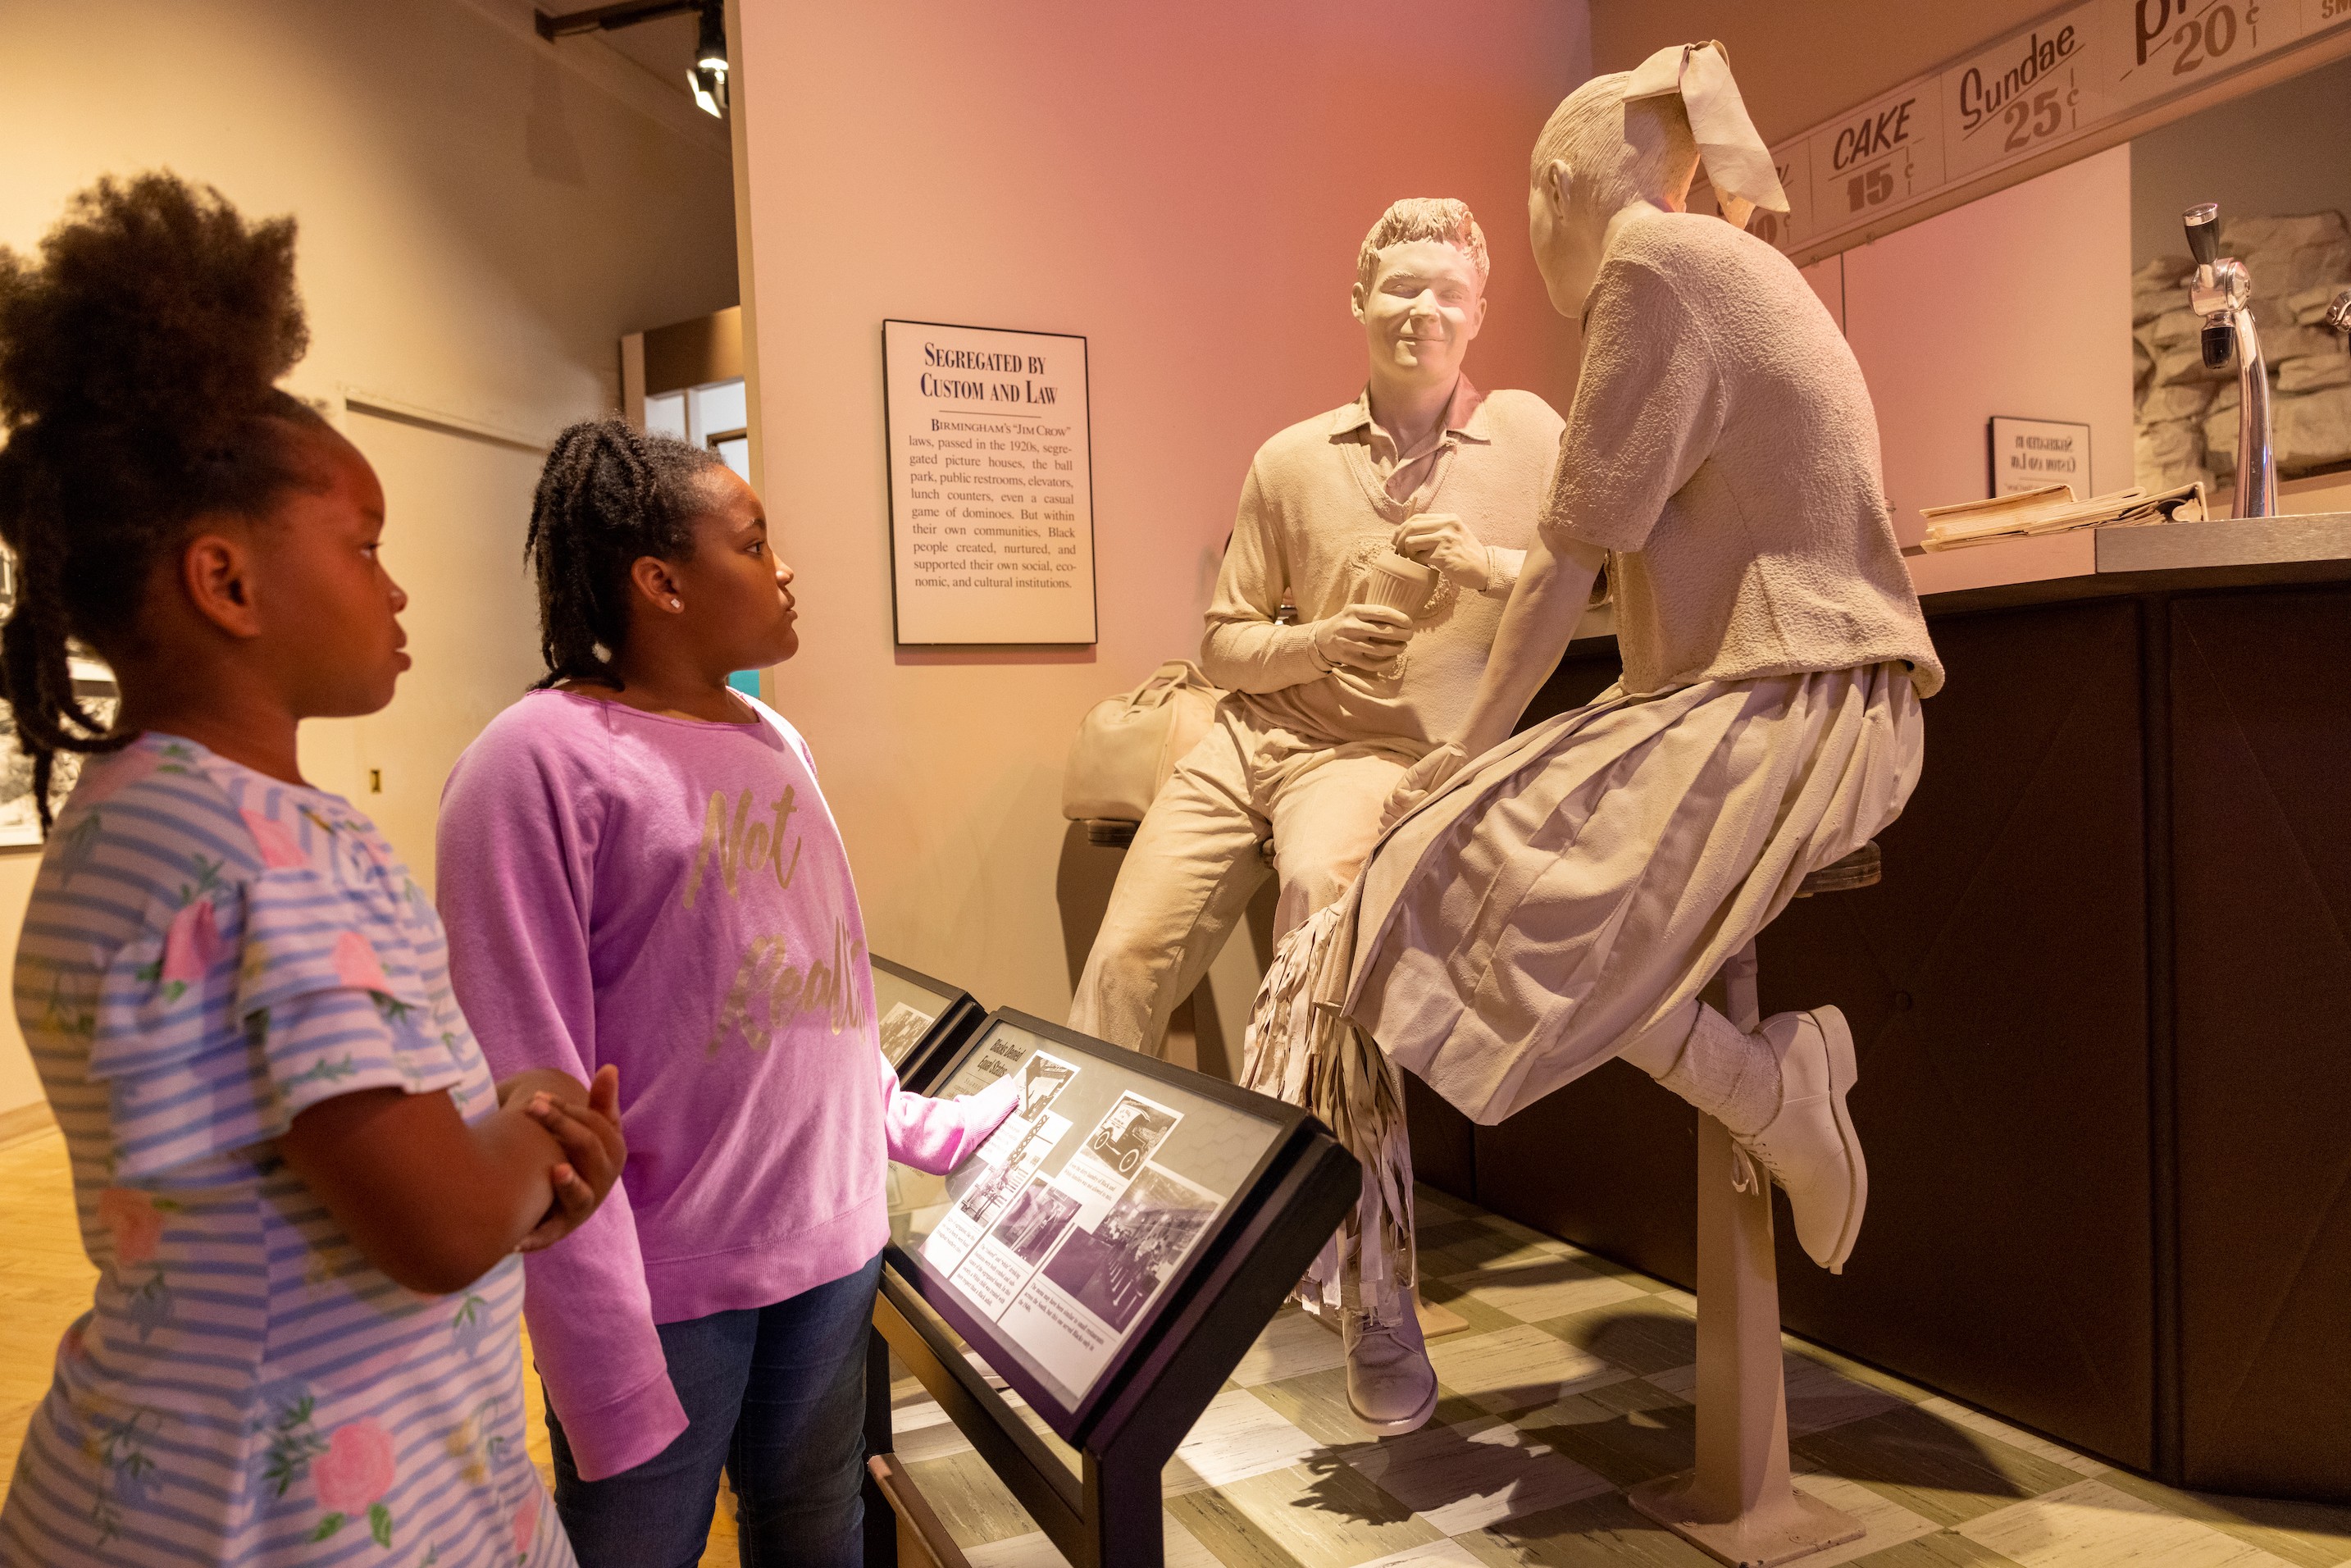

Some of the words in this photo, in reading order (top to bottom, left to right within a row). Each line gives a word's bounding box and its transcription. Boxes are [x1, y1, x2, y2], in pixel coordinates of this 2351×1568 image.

[1961, 25, 2075, 130] Sundae
[1834, 98, 1916, 171] CAKE
[924, 341, 1023, 373] SEGREGATED
[1027, 355, 1046, 376] BY
[919, 371, 985, 401] CUSTOM
[990, 383, 1021, 403] AND
[1025, 380, 1058, 405] LAW
[909, 435, 935, 448] laws,
[937, 438, 973, 451] passed
[976, 438, 986, 450] in
[989, 440, 1006, 451] the
[1010, 440, 1040, 454] 1920s,
[1042, 444, 1072, 457] segre-
[909, 453, 938, 467] gated
[945, 454, 982, 469] picture
[988, 456, 1026, 469] houses,
[1032, 458, 1048, 470] the
[1054, 459, 1073, 471] ball
[910, 470, 937, 485] park,
[939, 472, 972, 485] public
[973, 475, 1026, 486] restrooms,
[1027, 475, 1074, 489] elevators,
[911, 487, 941, 499] lunch
[946, 492, 994, 503] counters,
[1000, 494, 1024, 503] even
[1031, 495, 1037, 504] a
[1043, 494, 1074, 504] casual
[911, 508, 940, 520] game
[945, 506, 957, 518] of
[962, 507, 1014, 520] dominoes.
[1020, 508, 1038, 521] But
[1043, 510, 1075, 522] within
[912, 522, 937, 535] their
[944, 526, 967, 536] own
[973, 526, 1041, 538] communities,
[1048, 526, 1076, 538] Black
[913, 540, 949, 555] people
[955, 542, 996, 554] created,
[1004, 544, 1051, 555] nurtured,
[1058, 544, 1077, 555] and
[914, 558, 967, 573] supported
[969, 558, 994, 571] their
[996, 562, 1018, 571] own
[1021, 560, 1053, 572] social,
[1055, 563, 1077, 572] eco-
[914, 576, 950, 588] nomic,
[952, 576, 972, 587] and
[973, 577, 1014, 588] cultural
[1015, 577, 1072, 589] institutions.
[683, 783, 802, 909] Not
[990, 1038, 1008, 1055] Blacks
[1004, 1044, 1026, 1062] Denied
[977, 1055, 996, 1072] Equal
[989, 1060, 1007, 1078] Status
